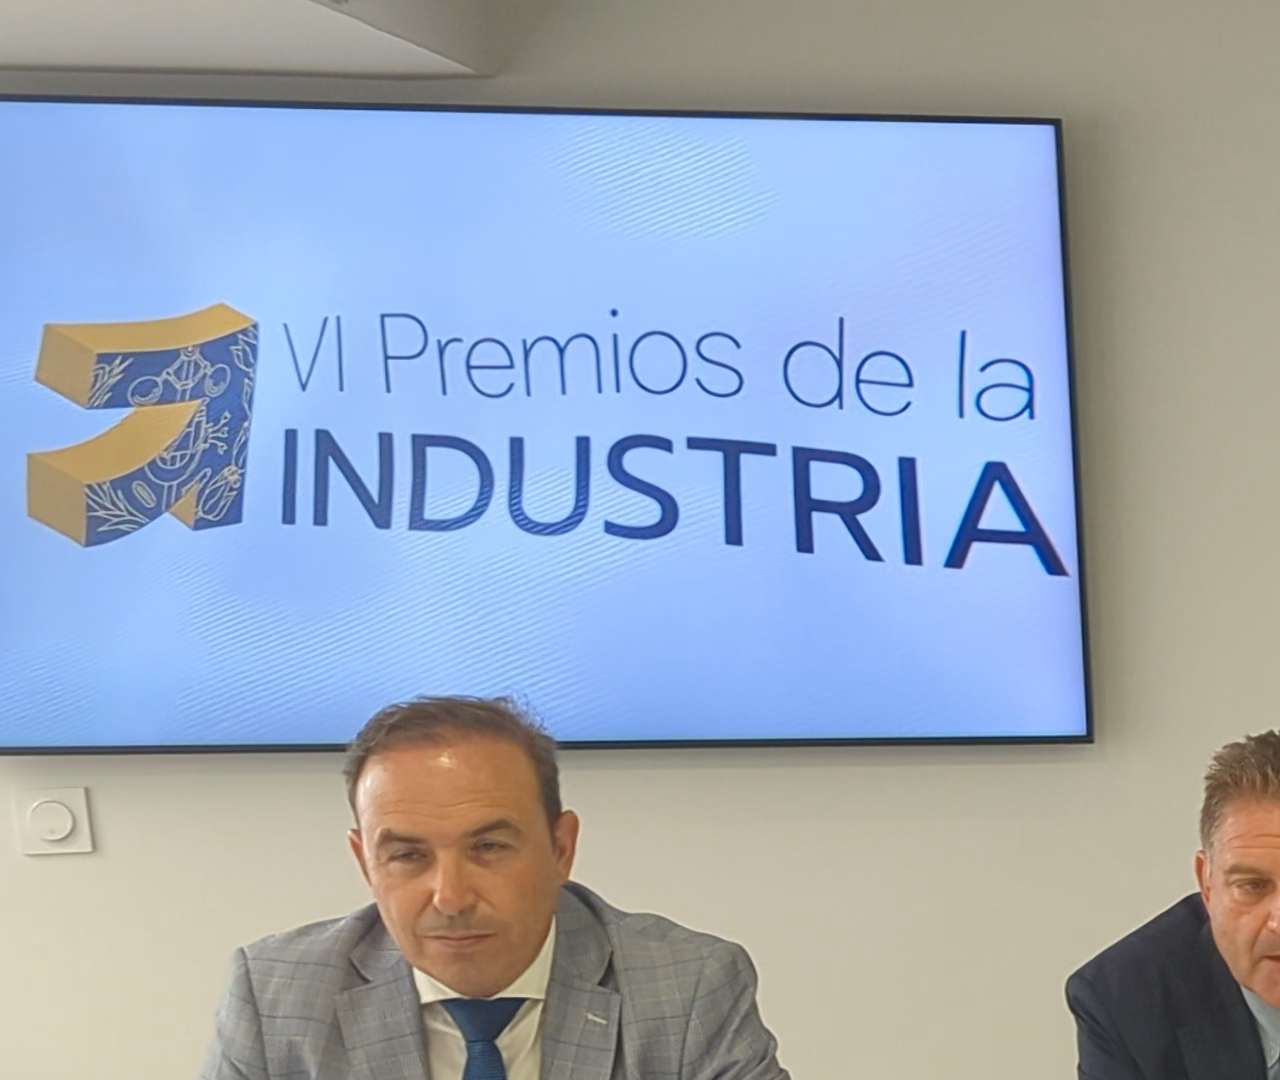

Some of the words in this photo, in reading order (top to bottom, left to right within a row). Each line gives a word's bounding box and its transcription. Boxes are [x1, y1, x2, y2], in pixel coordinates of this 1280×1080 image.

[282, 315, 344, 393] VI
[379, 308, 744, 399] Premios
[783, 316, 914, 417] de
[958, 329, 1035, 422] la
[281, 427, 1071, 578] INDUSTRIA
